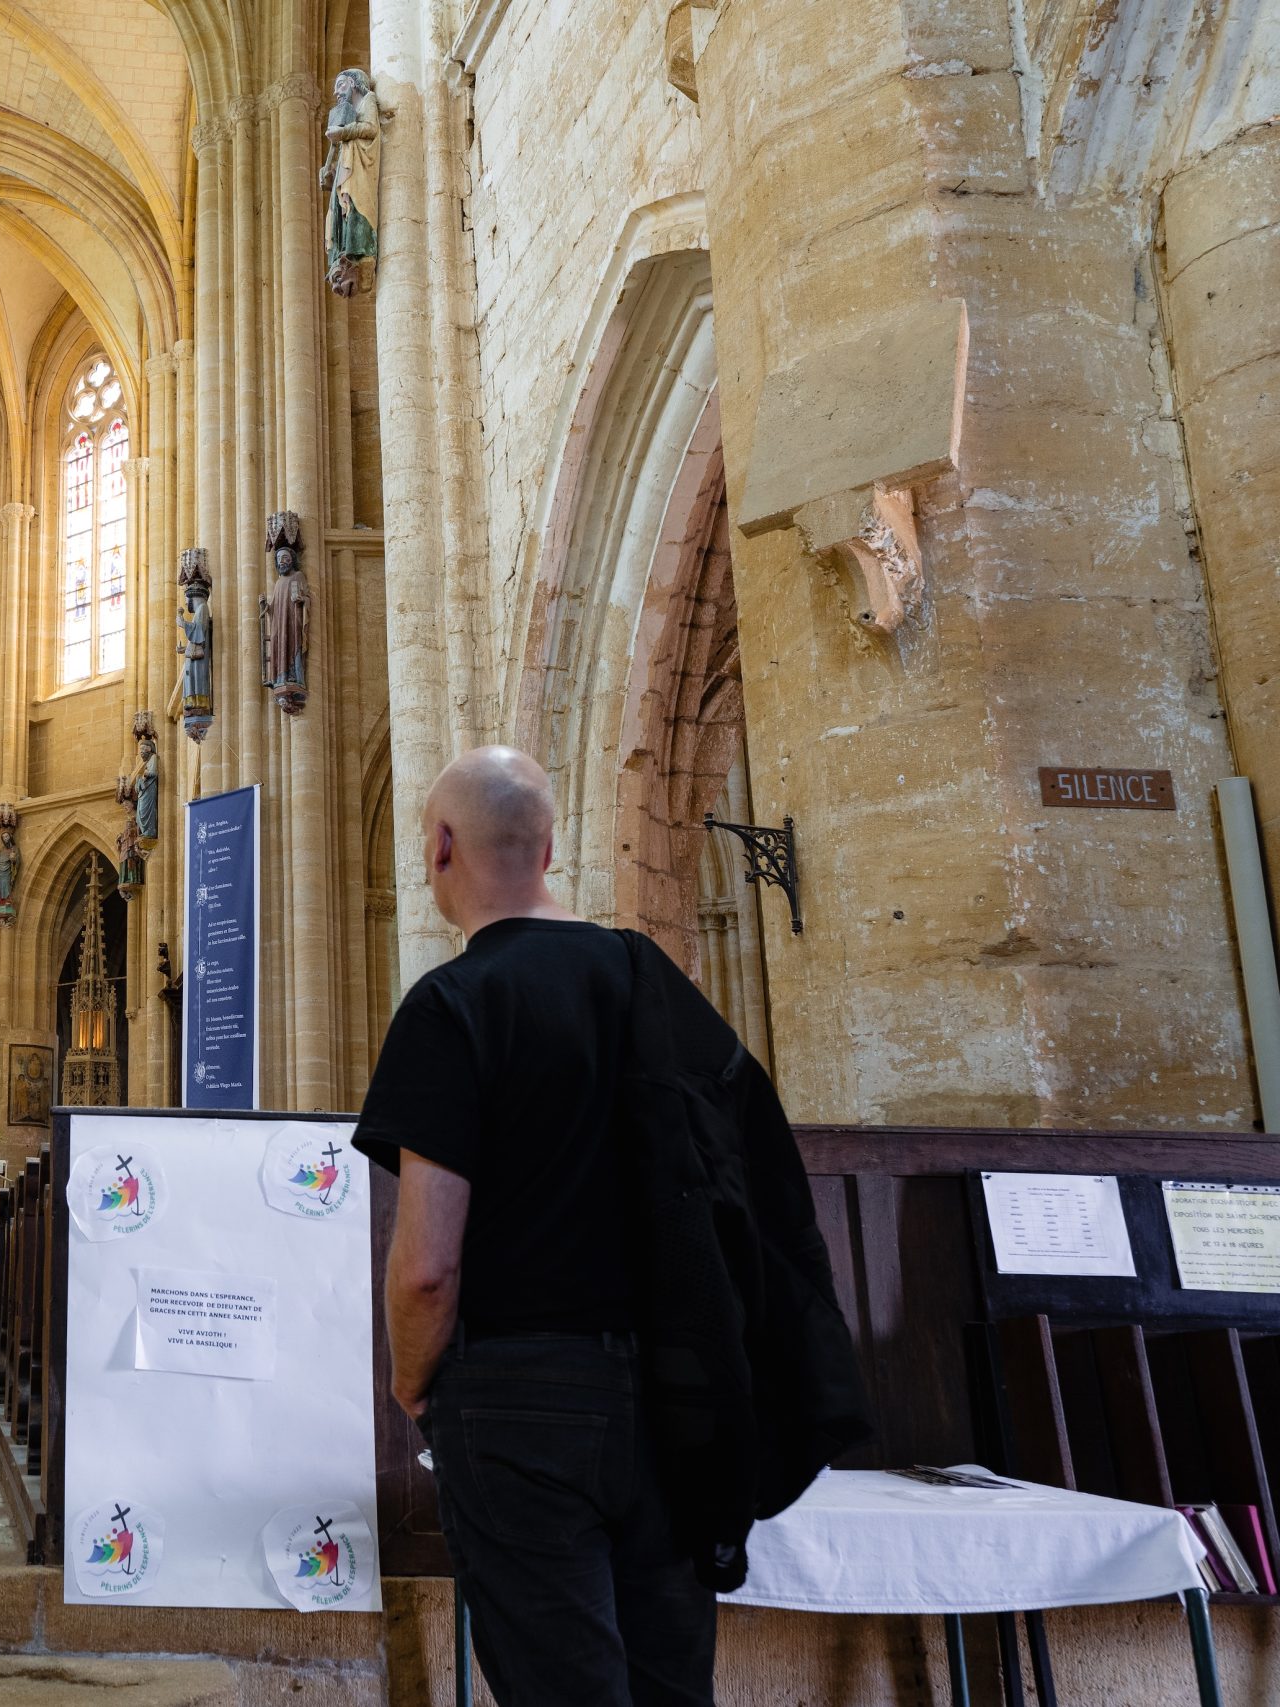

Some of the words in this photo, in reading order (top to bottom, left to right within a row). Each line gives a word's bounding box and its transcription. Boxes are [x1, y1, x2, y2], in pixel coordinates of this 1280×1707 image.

[1057, 773, 1158, 803] SILENCE
[325, 1206, 335, 1215] DE
[142, 1215, 151, 1224] DE
[151, 1288, 189, 1297] MARCHONS
[210, 1292, 256, 1302] L'ESPERANCE,
[150, 1297, 169, 1305] POUR
[170, 1299, 204, 1307] RECEVOIR
[149, 1307, 176, 1315] GRACES
[178, 1328, 194, 1336] VIVE
[196, 1330, 222, 1338] AVIOTH
[195, 1340, 232, 1349] BASILIQUE
[132, 1575, 142, 1585] DE
[342, 1585, 352, 1596] DE
